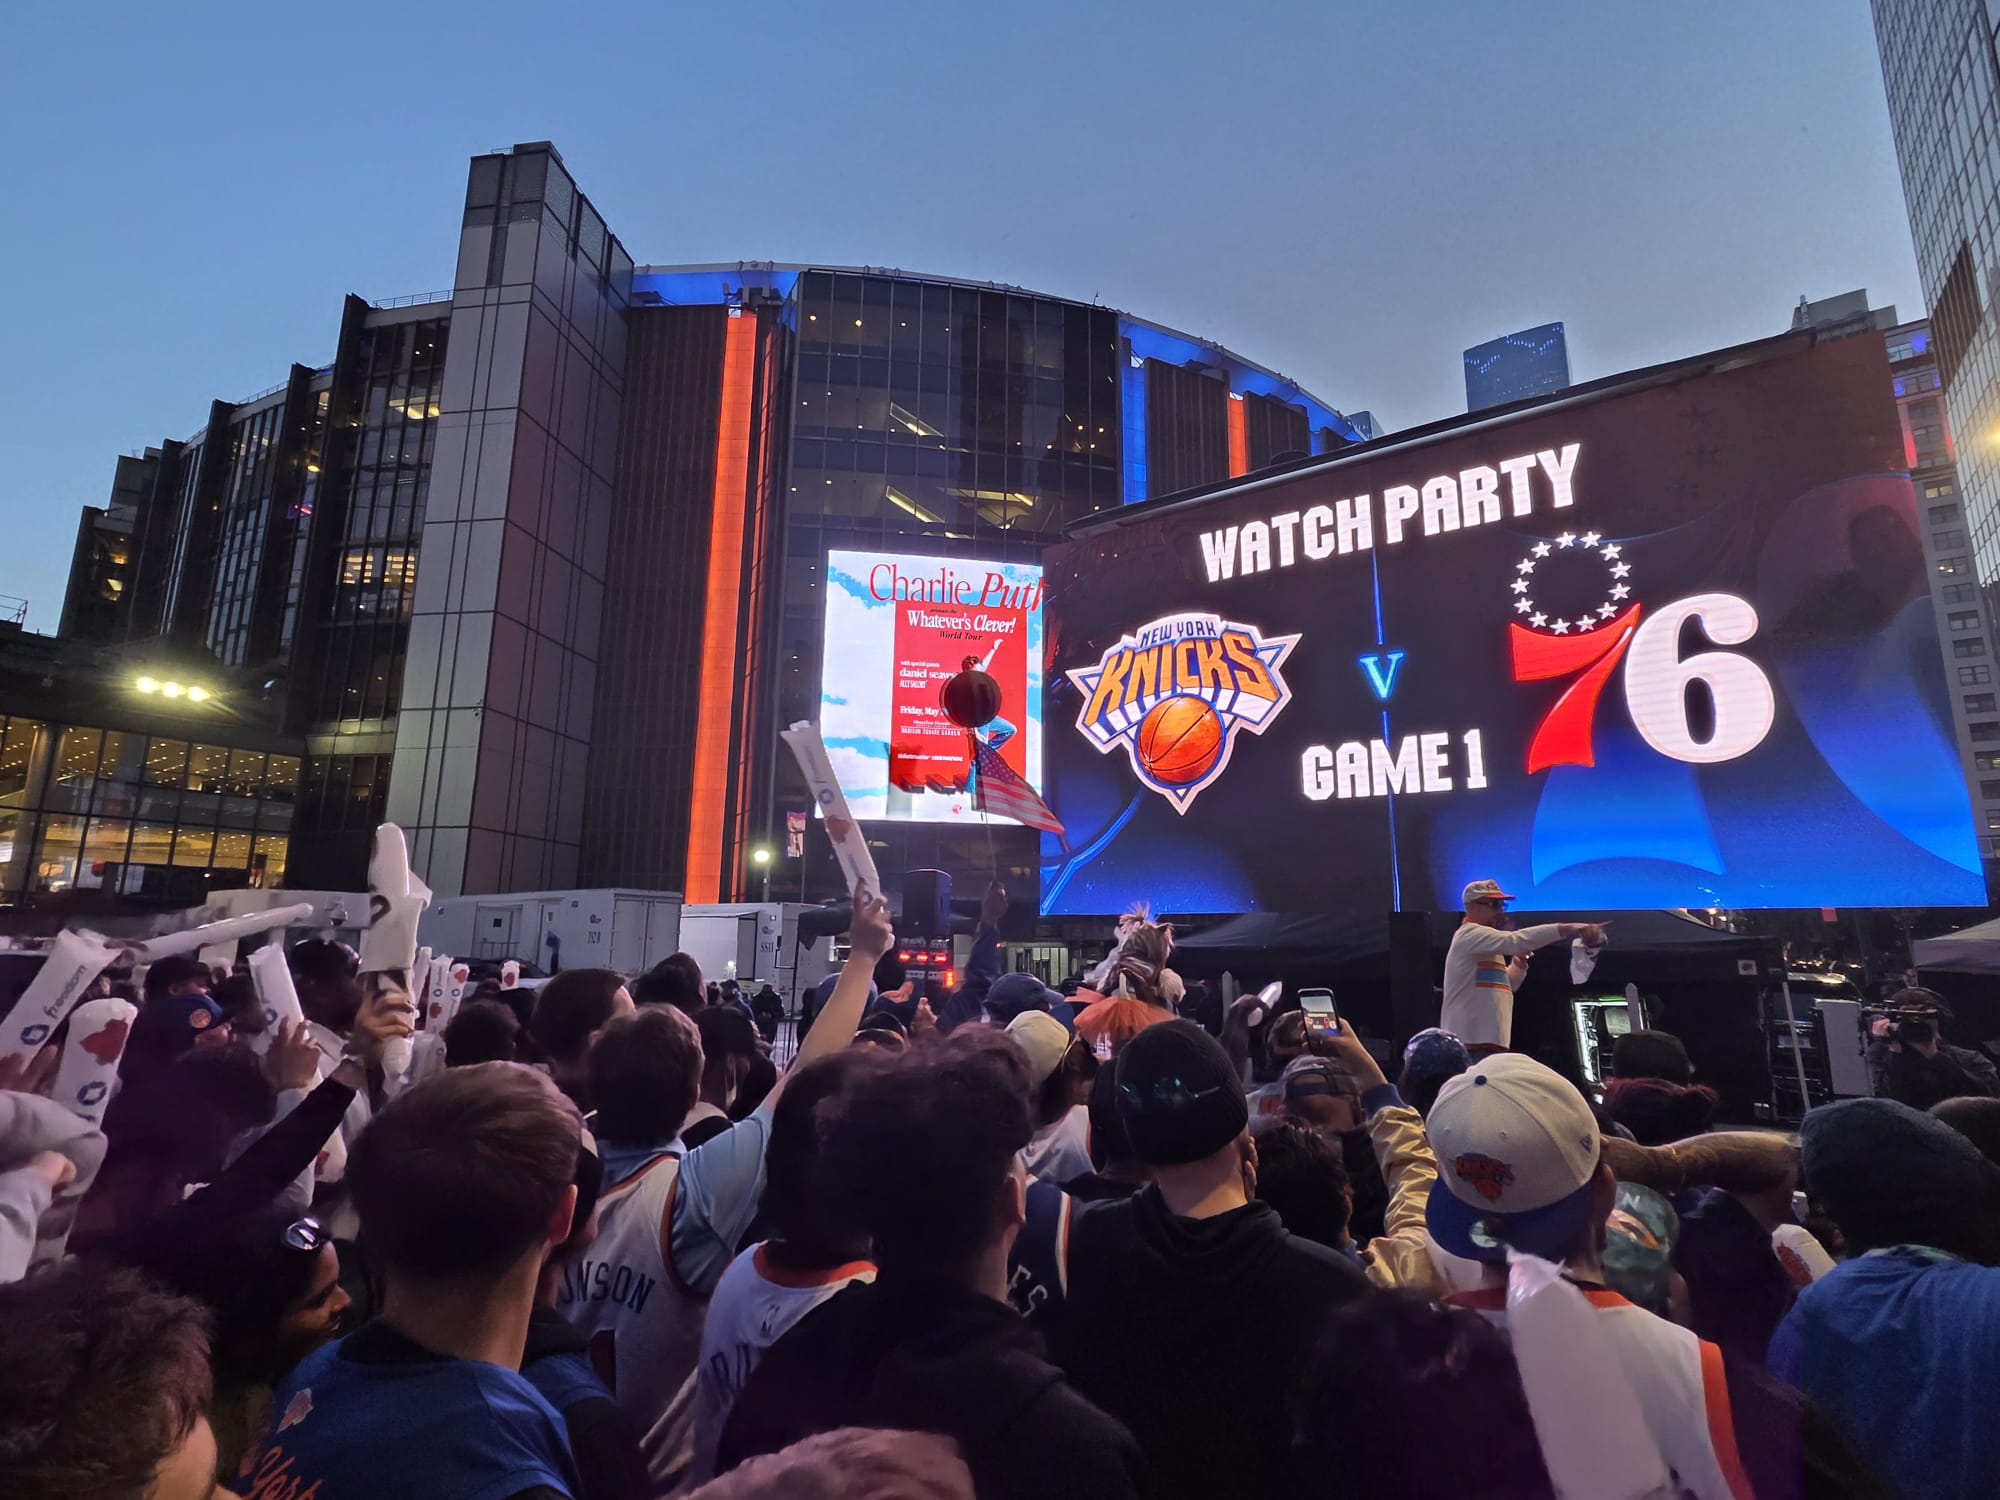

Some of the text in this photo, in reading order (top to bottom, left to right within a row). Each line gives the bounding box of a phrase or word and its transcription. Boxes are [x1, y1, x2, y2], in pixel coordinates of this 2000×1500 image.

[1200, 442, 1583, 583] WATCH PARTY
[869, 563, 971, 605] Charlie
[907, 609, 1017, 634] Whatever's Clever!
[940, 631, 984, 641] World Tour
[1141, 620, 1217, 648] NEW YORK
[900, 667, 927, 678] daniel
[1083, 631, 1282, 728] KNICKS
[1510, 594, 1776, 775] 76
[900, 705, 940, 717] Friday, May
[1302, 729, 1488, 801] GAME 1
